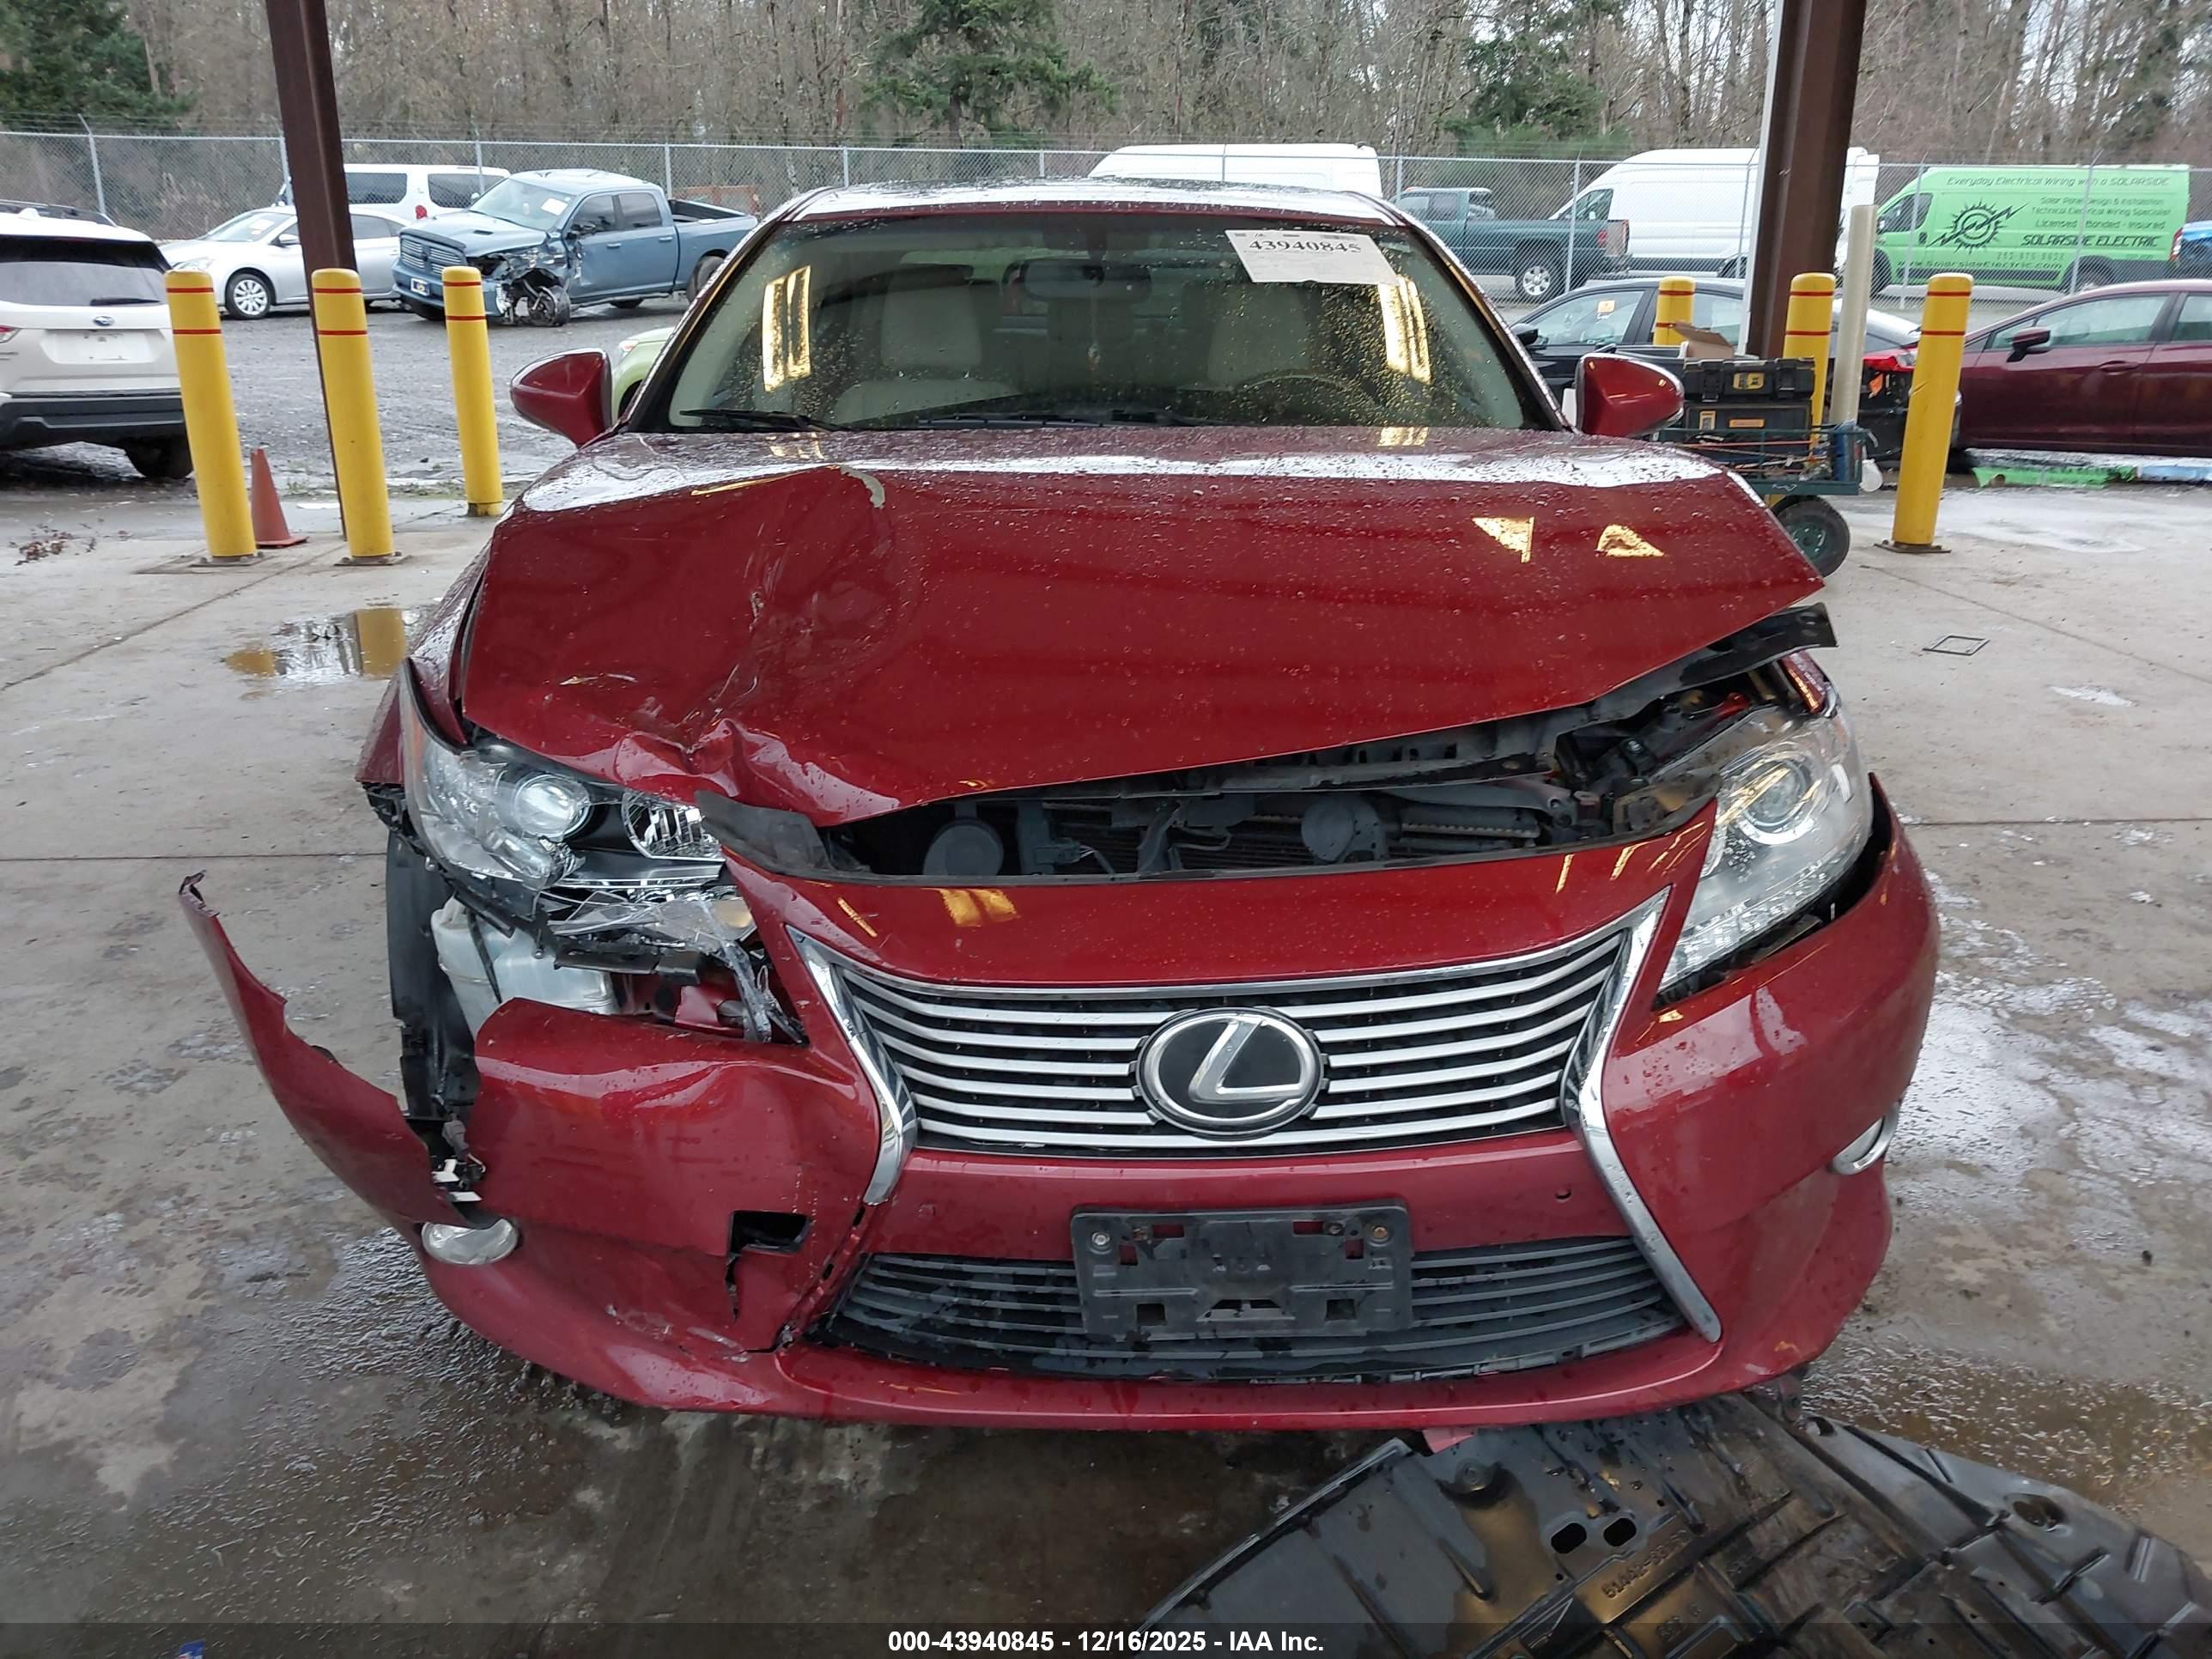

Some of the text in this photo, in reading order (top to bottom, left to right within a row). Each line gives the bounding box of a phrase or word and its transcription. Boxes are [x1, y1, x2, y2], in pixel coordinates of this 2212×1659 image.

[1947, 176, 1995, 188] Everyday
[1996, 176, 2043, 186] Electrical
[2044, 176, 2076, 188] Wiring
[2109, 177, 2171, 187] SOLARSIDE
[1249, 240, 1362, 253] 43940845
[2095, 235, 2161, 248] ELECTRIC
